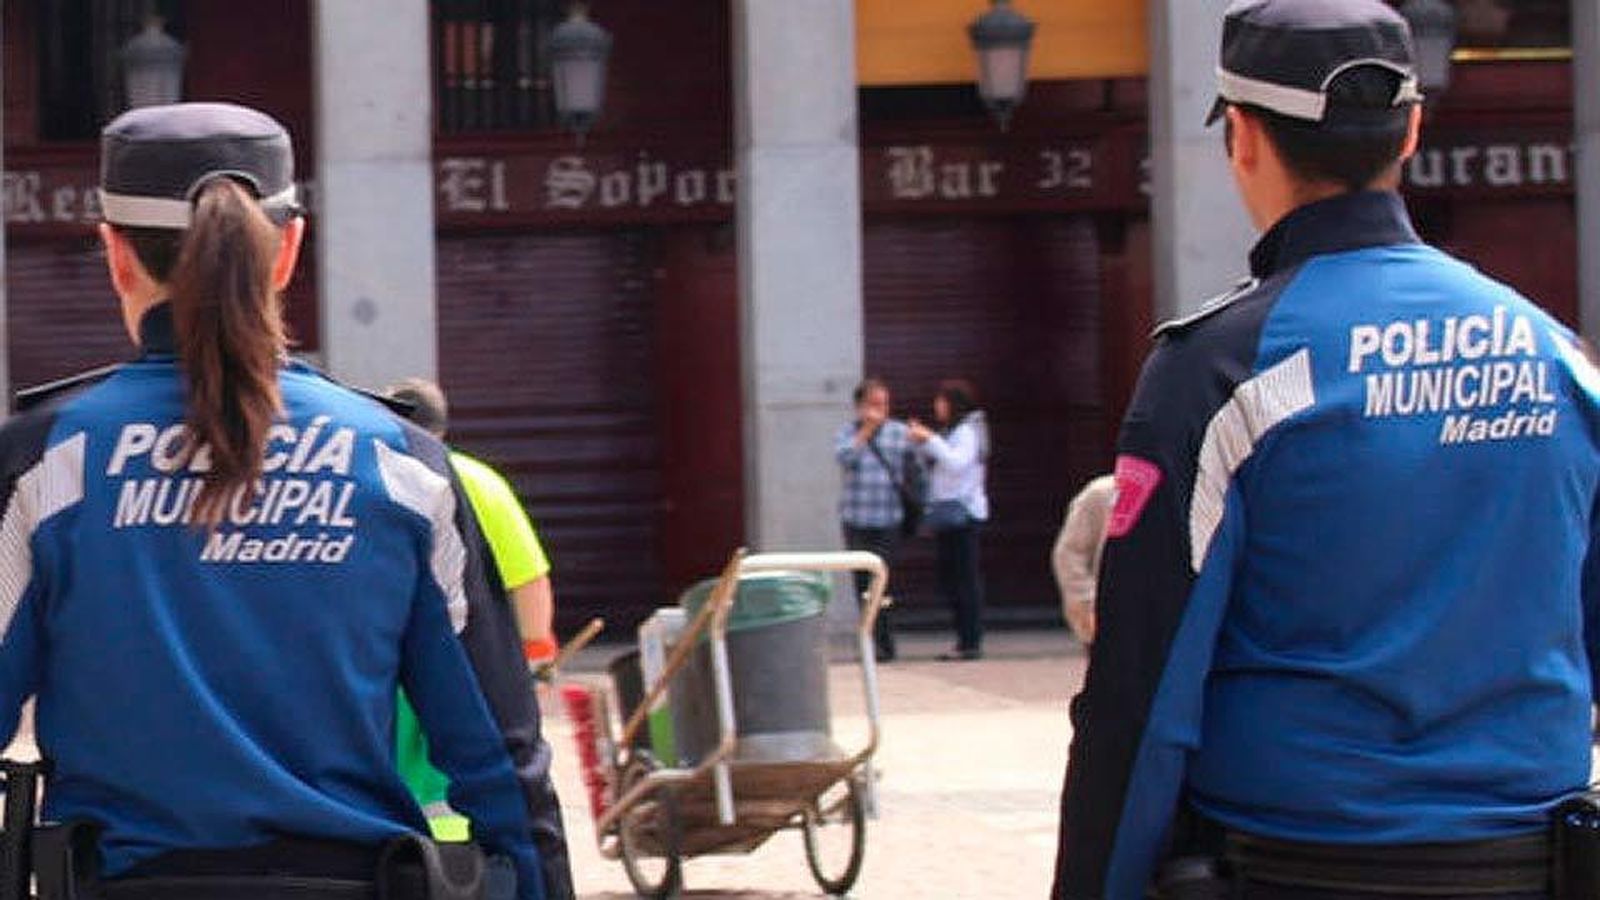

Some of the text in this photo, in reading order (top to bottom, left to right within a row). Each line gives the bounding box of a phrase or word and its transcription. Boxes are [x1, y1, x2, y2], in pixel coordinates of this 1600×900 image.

[442, 156, 739, 211] El Sopor
[888, 146, 1003, 198] Bar
[1039, 151, 1092, 188] 32
[1408, 145, 1572, 187] uran
[3, 170, 102, 222] Res
[1348, 303, 1536, 373] POLICÍA
[1364, 361, 1556, 418] MUNICIPAL
[106, 414, 356, 476] POLCÍA
[1440, 408, 1557, 443] Madrid
[200, 531, 353, 563] Madrid
